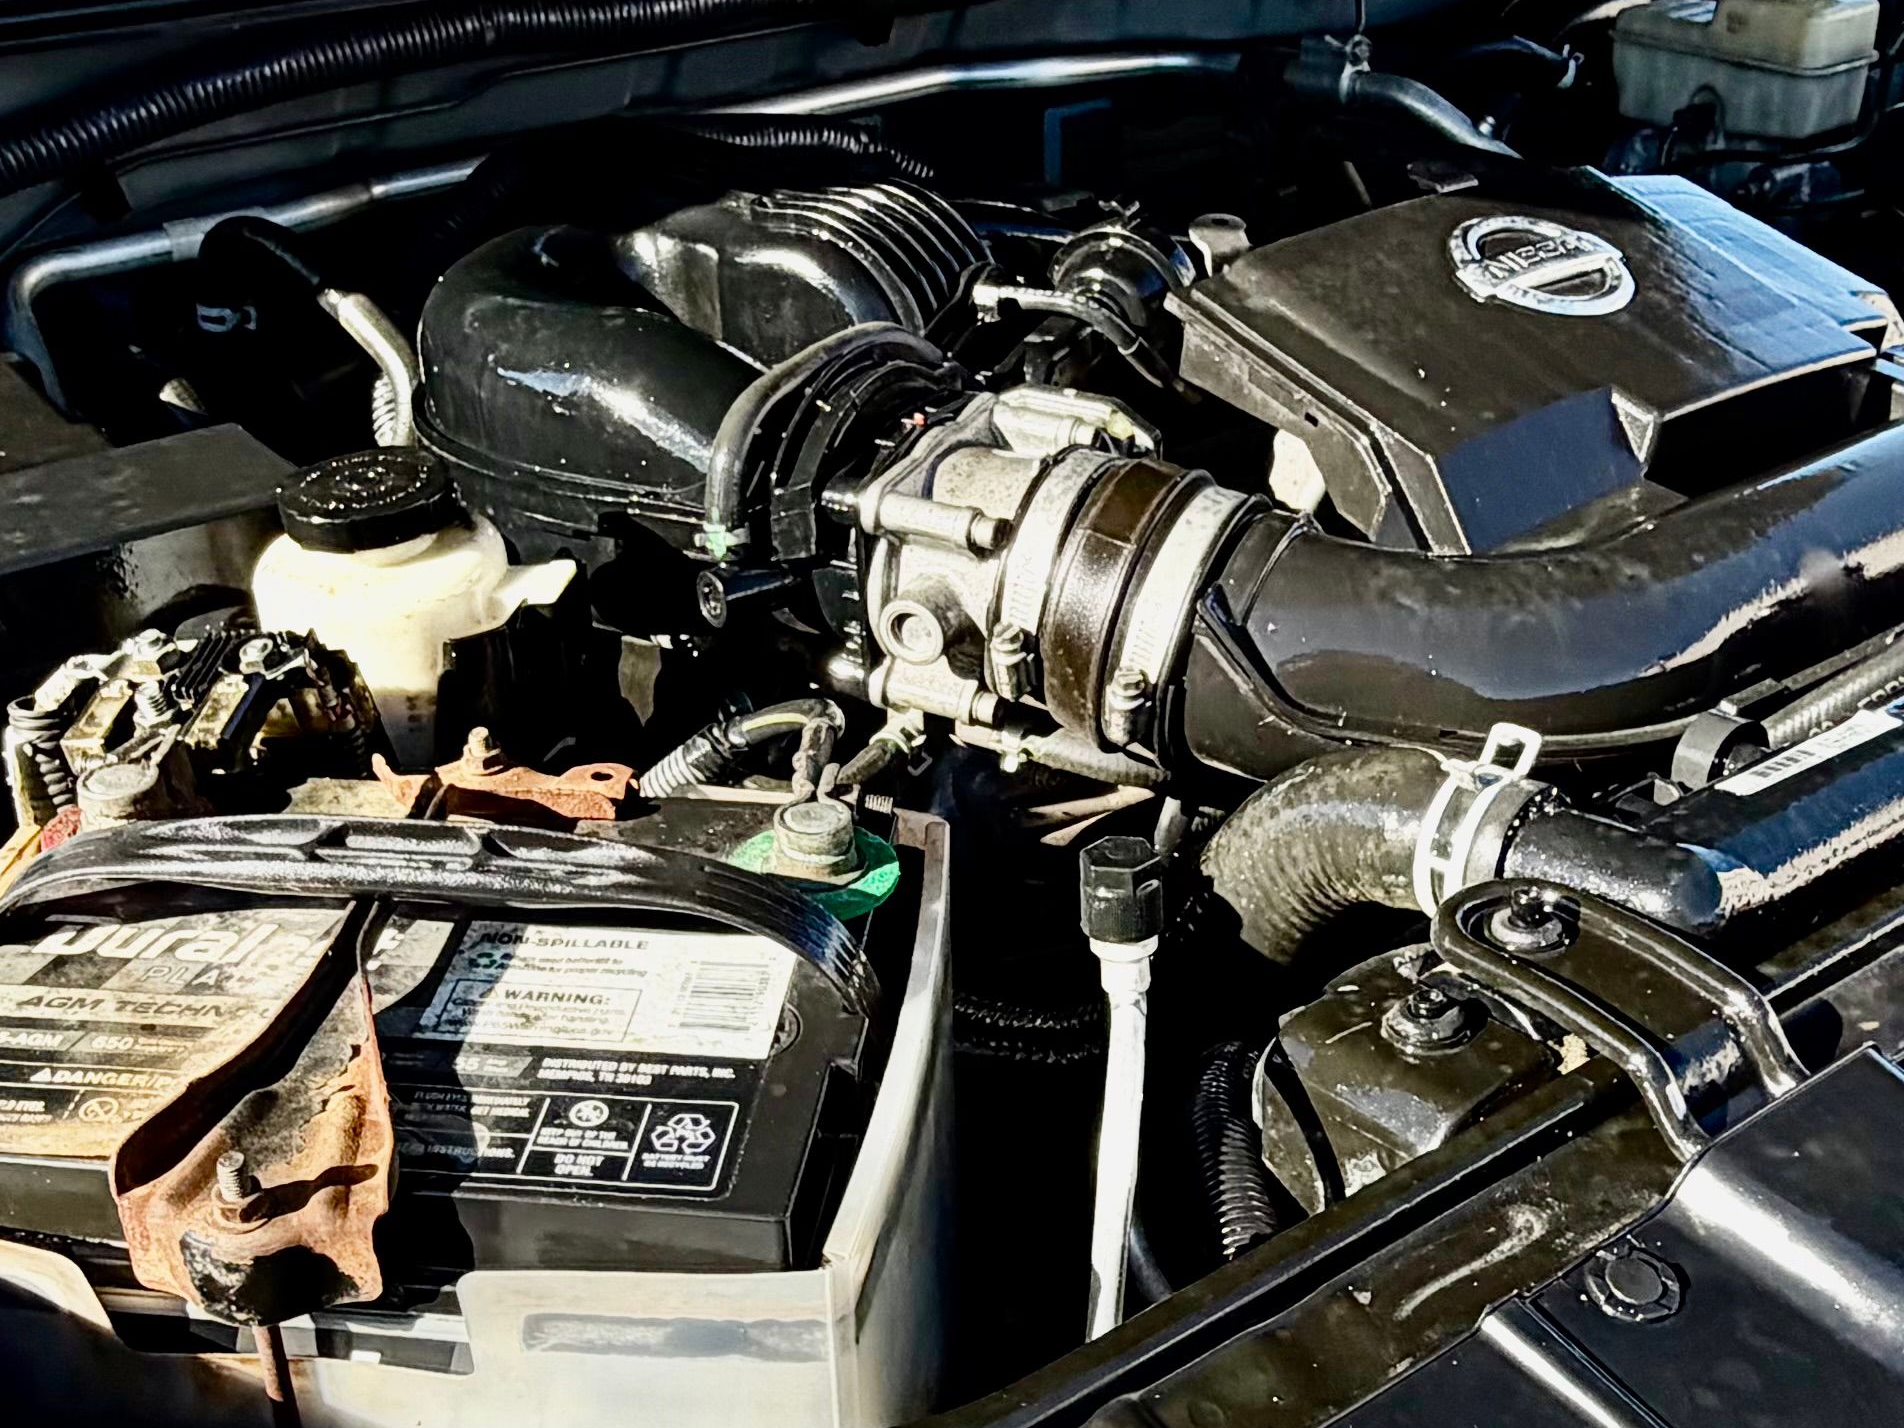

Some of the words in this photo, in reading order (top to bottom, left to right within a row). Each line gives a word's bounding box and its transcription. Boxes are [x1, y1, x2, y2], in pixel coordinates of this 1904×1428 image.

[480, 932, 649, 950] NON-SPILLABLE
[16, 995, 106, 1010] AGM
[505, 989, 610, 1005] WARNING:
